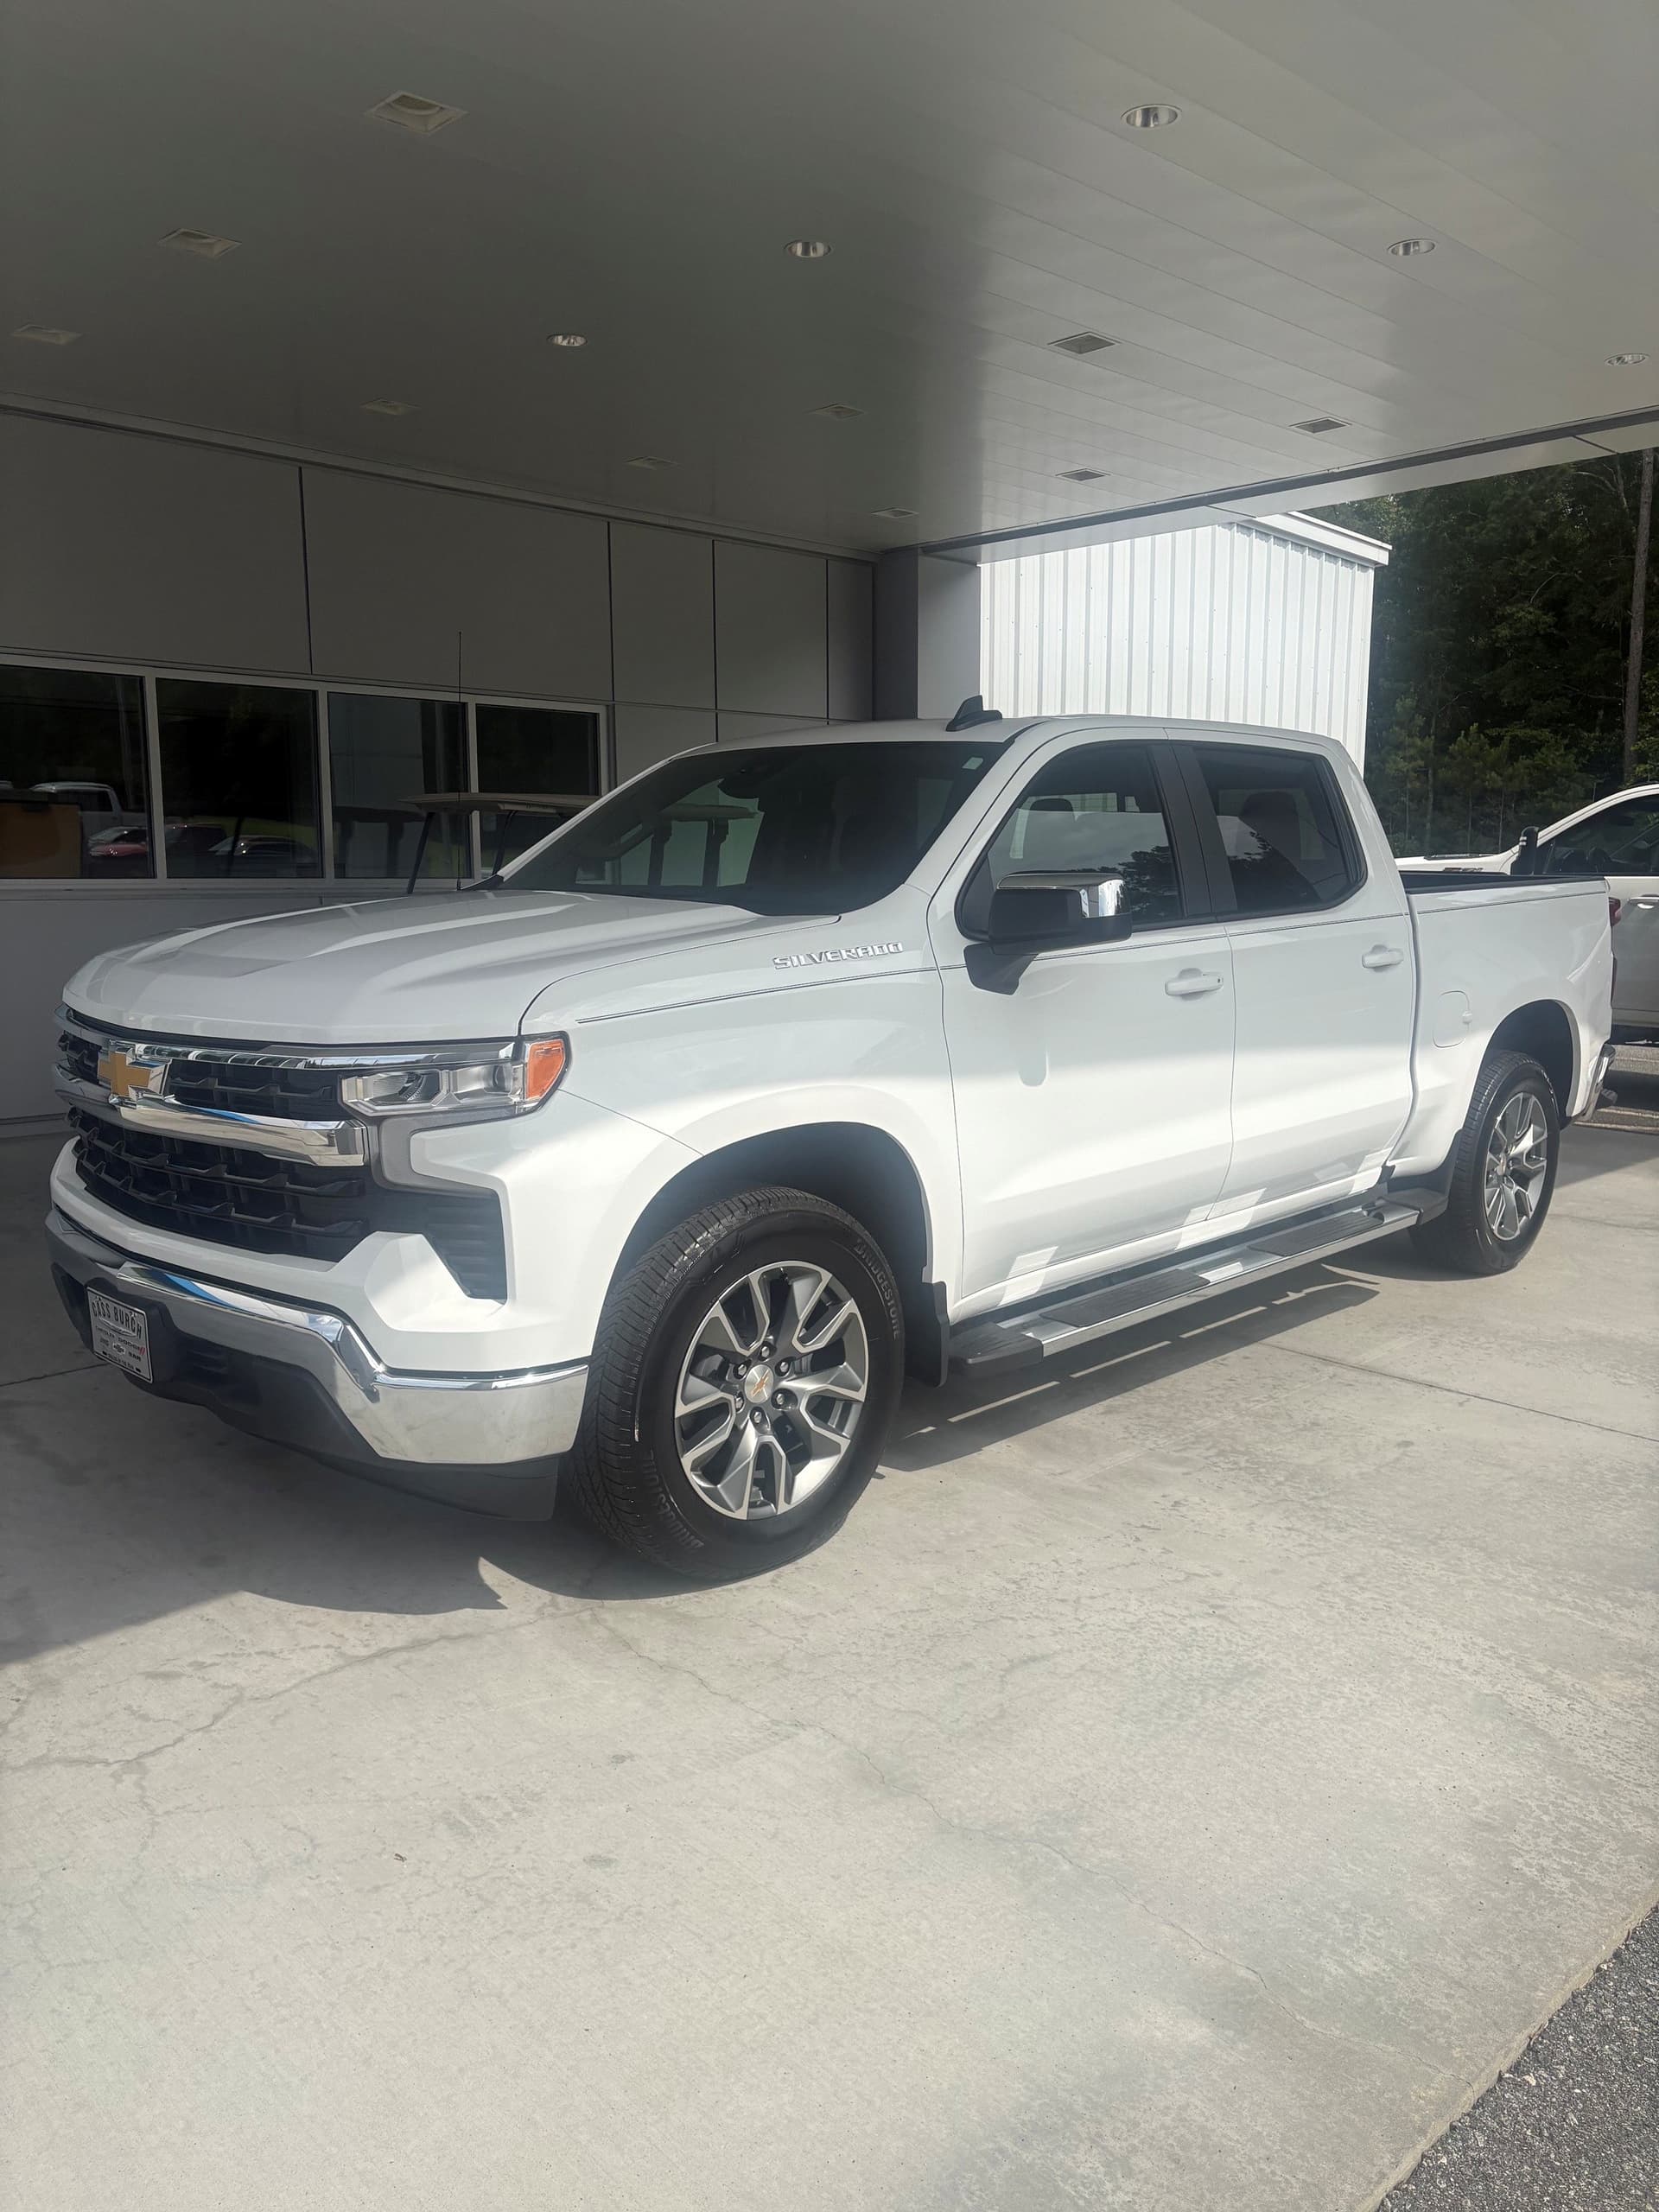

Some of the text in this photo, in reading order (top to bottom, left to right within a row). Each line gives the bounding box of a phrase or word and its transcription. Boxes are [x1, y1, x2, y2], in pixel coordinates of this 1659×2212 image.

[773, 942, 903, 969] SILVERADO
[92, 1300, 143, 1339] CASS BURCH
